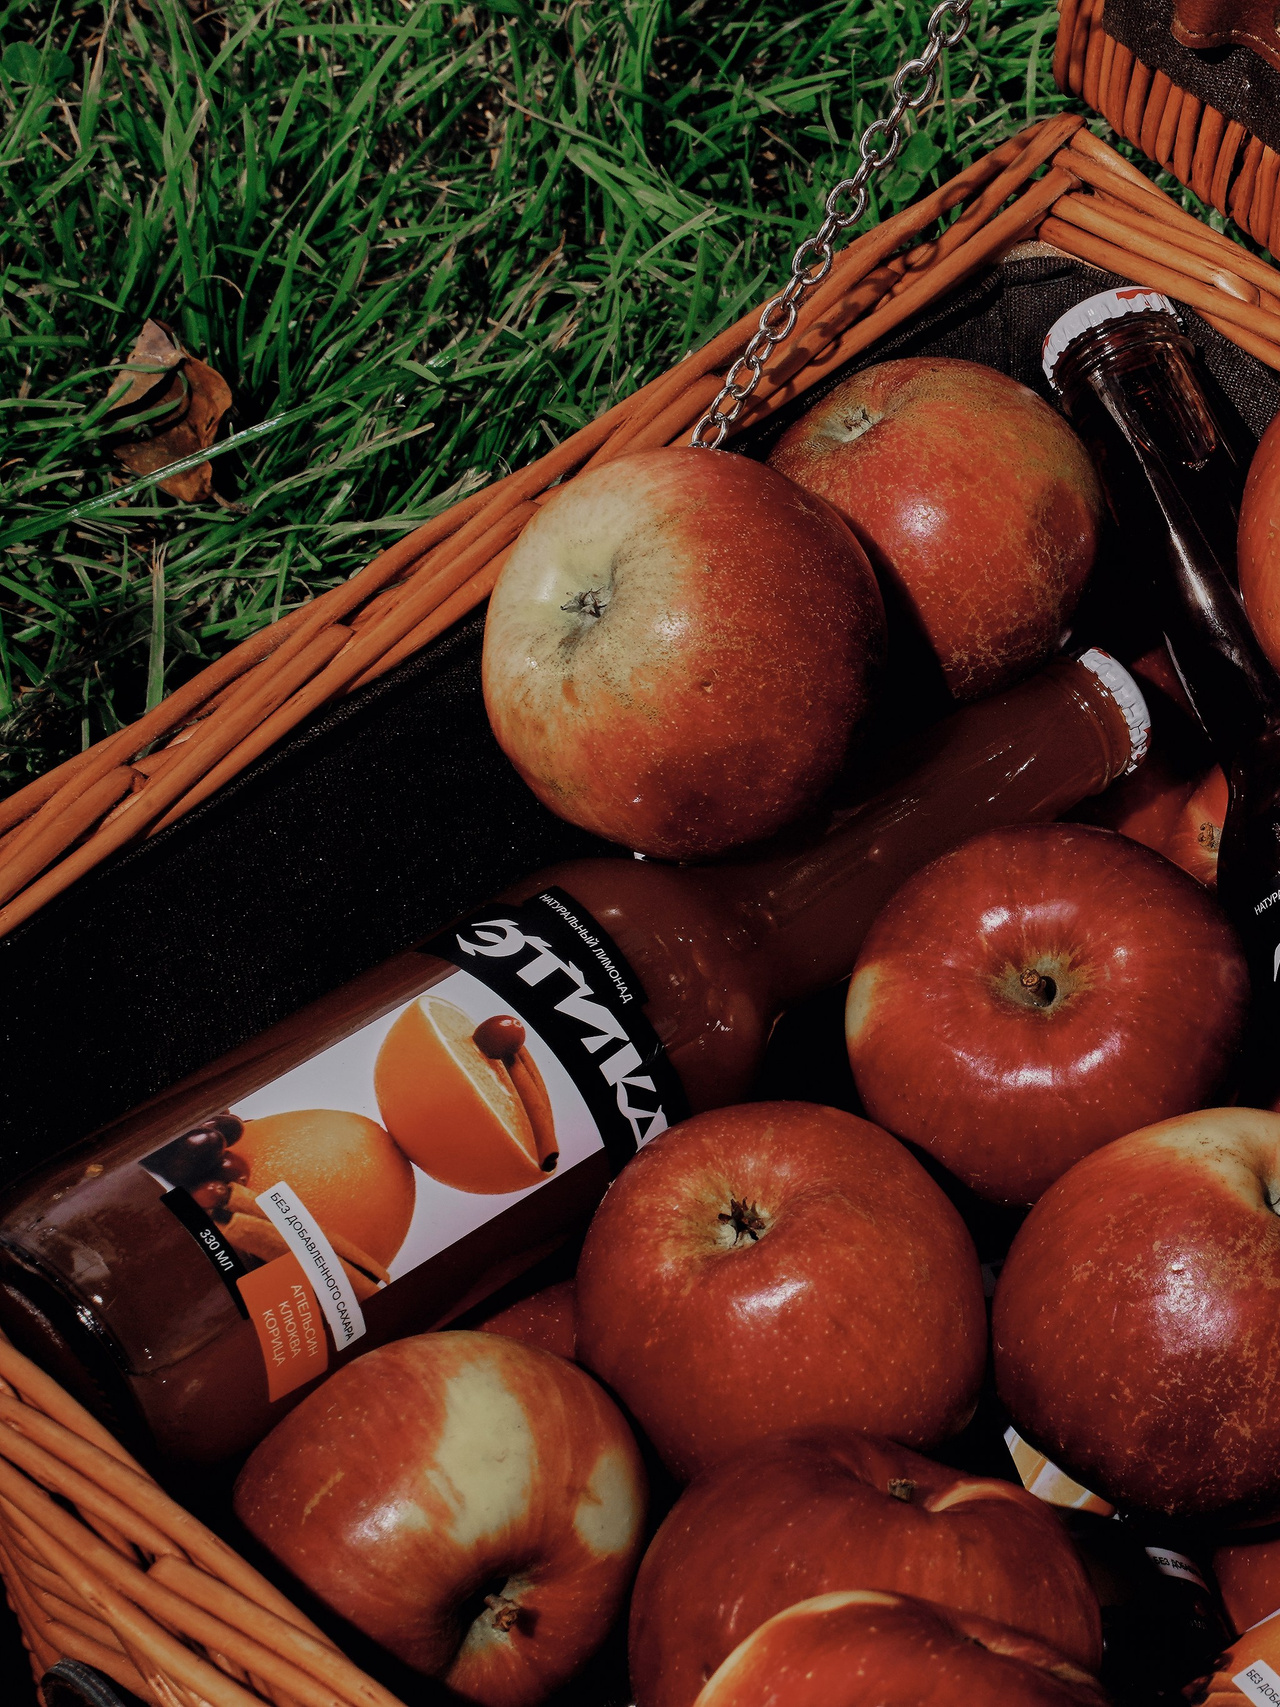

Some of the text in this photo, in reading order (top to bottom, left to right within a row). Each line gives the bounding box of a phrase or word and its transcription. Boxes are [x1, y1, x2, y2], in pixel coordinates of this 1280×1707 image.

[539, 894, 633, 1004] НАТУРАЛЬНЫЙ ЛИМОНАД
[456, 919, 671, 1153] ЭТИКА
[200, 1229, 234, 1272] 330 МЛ
[270, 1192, 355, 1341] БЕЗ ДОБАВЛЕННОГО САХАРА
[262, 1309, 286, 1367] КОРИЦА
[278, 1300, 301, 1358] КЛЮКВА
[290, 1284, 318, 1357] АПЕЛЬСИН
[1152, 1556, 1170, 1566] БЕЗ
[1246, 1669, 1264, 1685] БЕЗ
